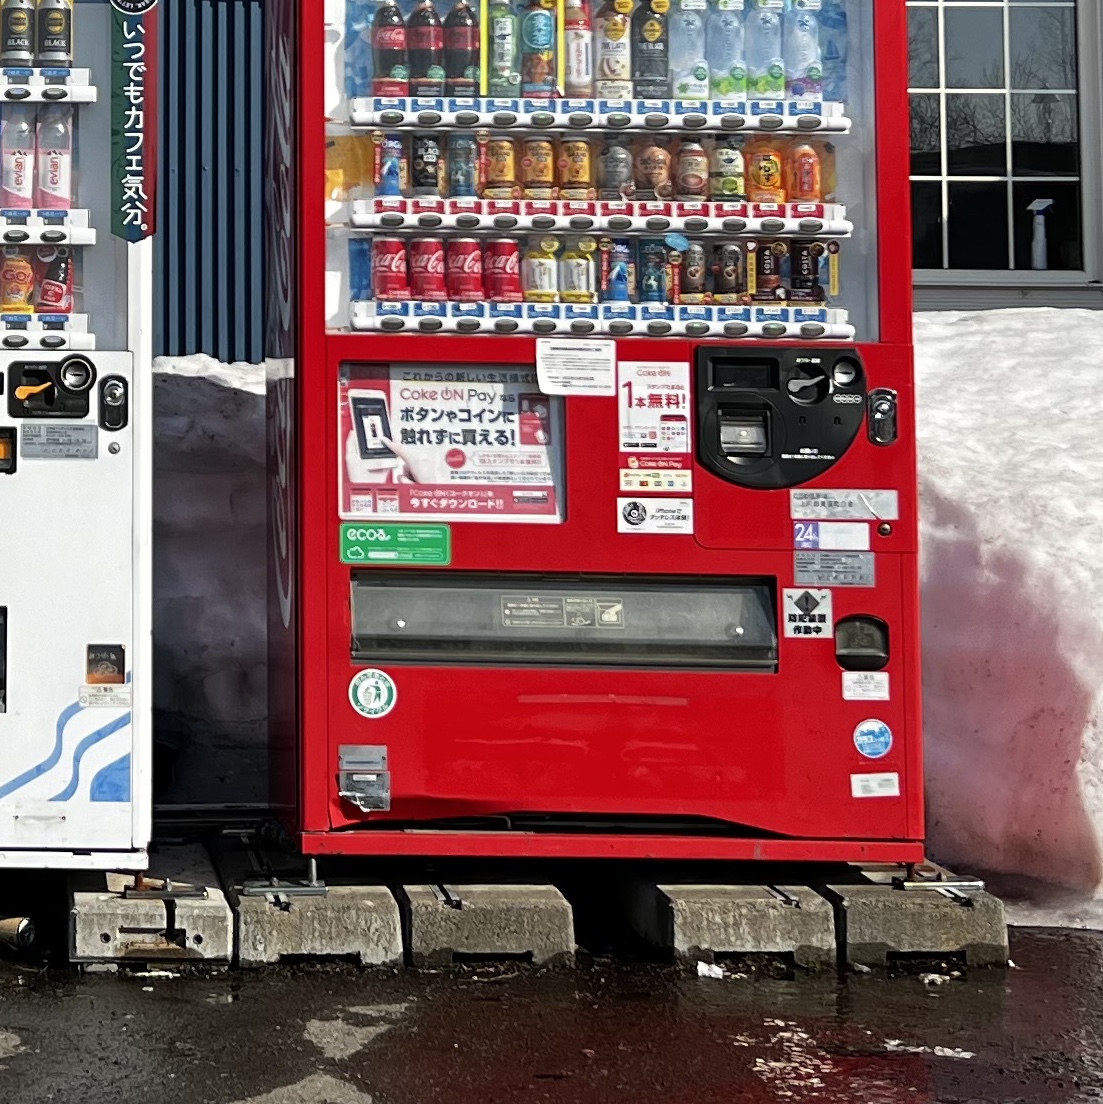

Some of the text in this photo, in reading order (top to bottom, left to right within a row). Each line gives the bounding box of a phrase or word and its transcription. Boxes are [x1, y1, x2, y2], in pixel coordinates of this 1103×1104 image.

[121, 20, 149, 232] いつでもカフェ気分。
[14, 157, 25, 187] evian
[49, 157, 60, 187] evian
[762, 249, 772, 275] COSTA
[400, 387, 437, 402] Coke
[439, 385, 464, 401] ON
[467, 388, 496, 405] Pay
[621, 380, 686, 410] 1本無料!
[400, 406, 516, 424] ボタンやコインに
